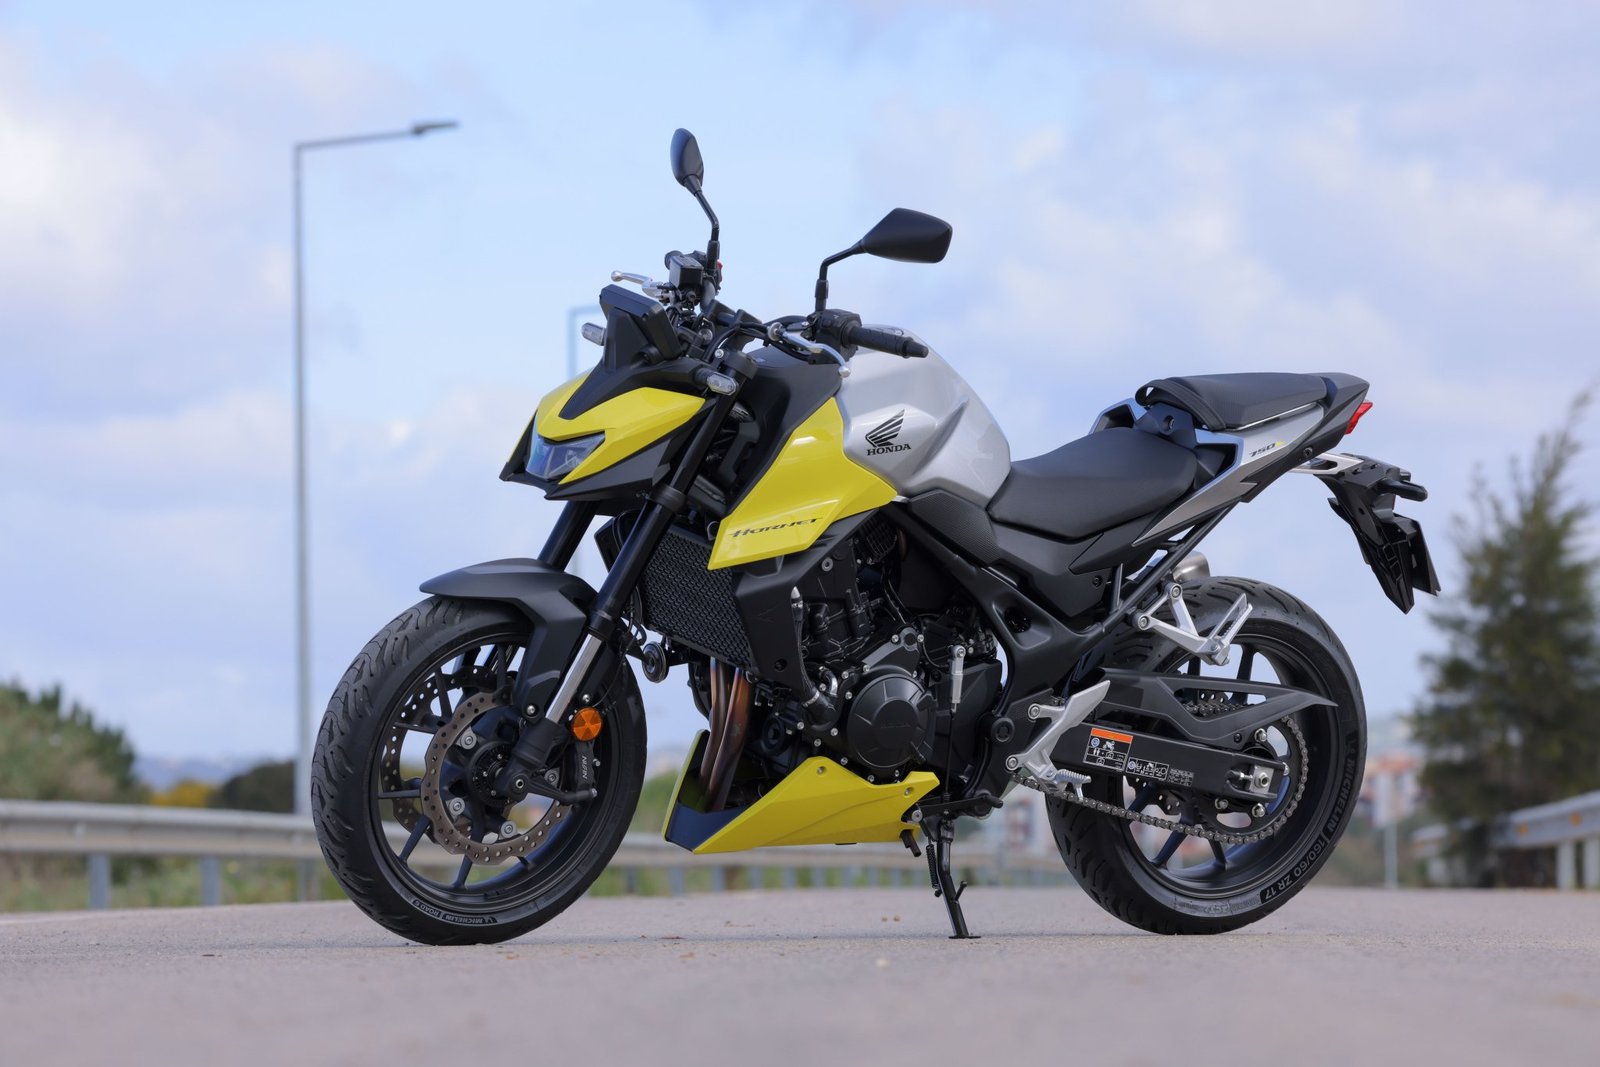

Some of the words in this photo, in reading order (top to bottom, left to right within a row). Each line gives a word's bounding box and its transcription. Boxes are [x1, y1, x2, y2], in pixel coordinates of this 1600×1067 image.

[867, 443, 911, 456] HONDA
[1249, 443, 1276, 457] 750
[1326, 758, 1356, 833] MICHELIN
[1293, 839, 1326, 877] 160/60
[1277, 874, 1293, 891] ZR
[1265, 887, 1277, 900] 17
[420, 903, 440, 916] ROAD
[445, 915, 483, 924] MICHELIN
